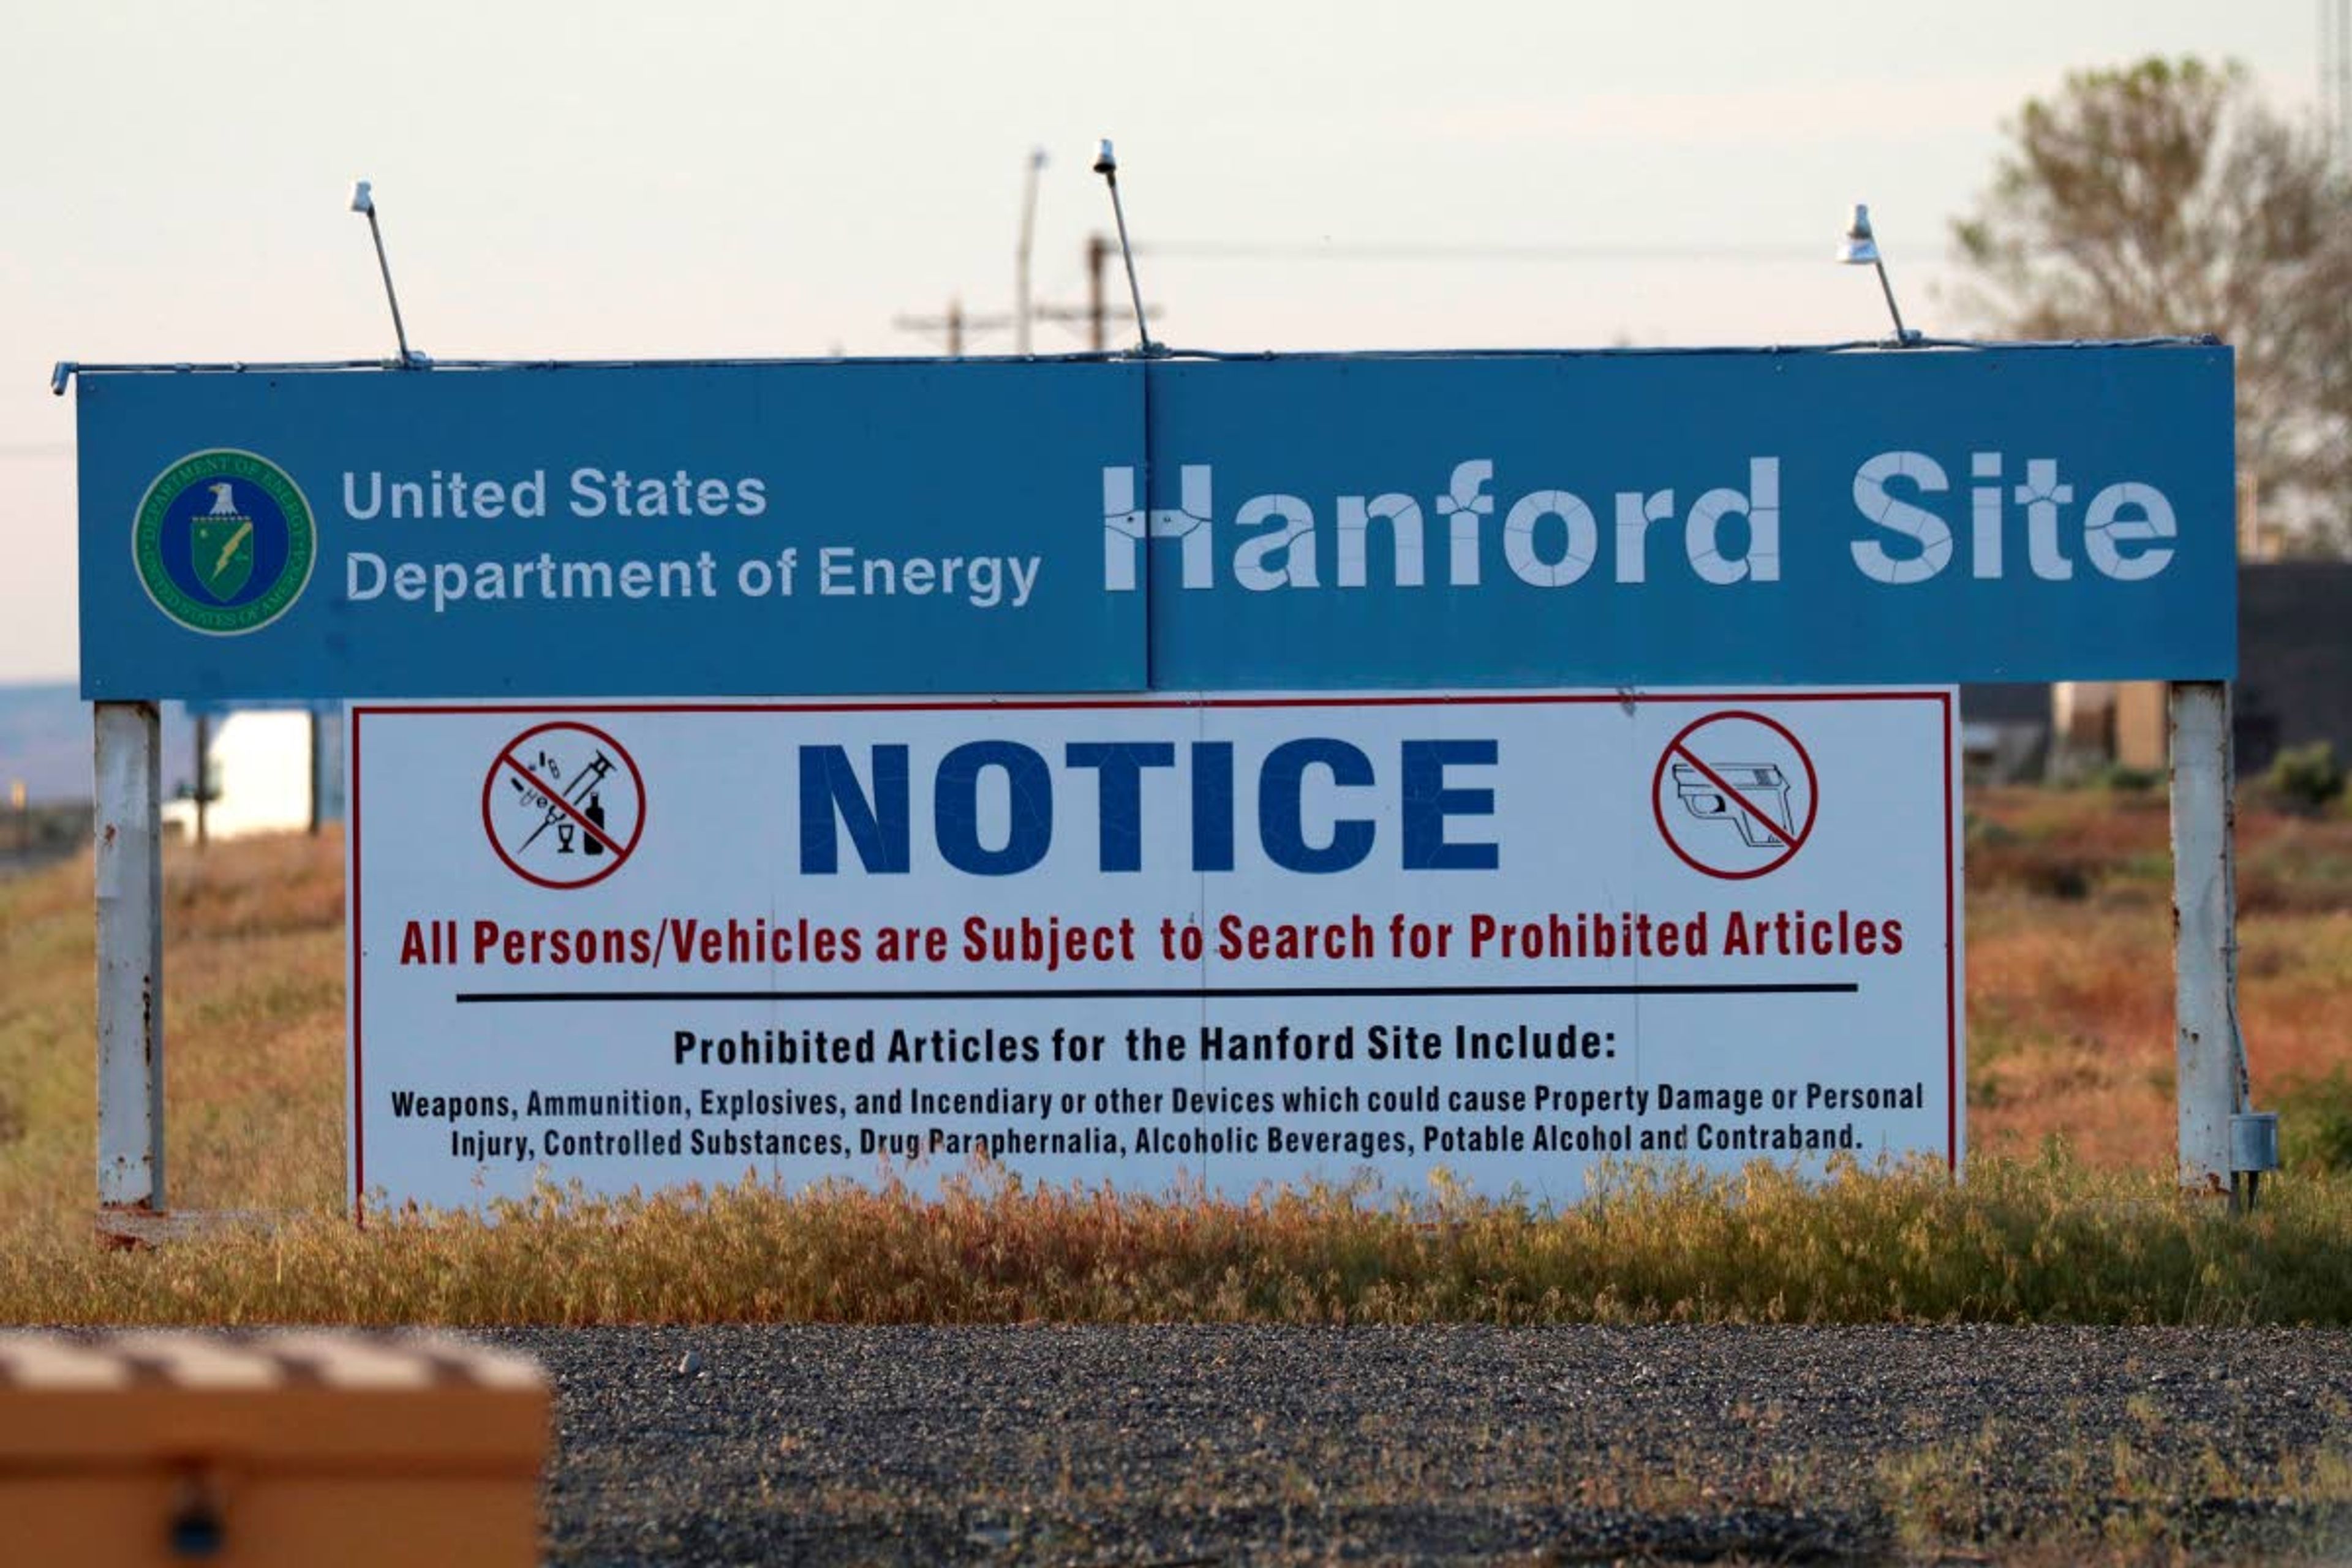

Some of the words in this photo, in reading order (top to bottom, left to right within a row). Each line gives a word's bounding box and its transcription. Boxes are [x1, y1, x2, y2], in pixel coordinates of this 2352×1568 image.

[343, 470, 546, 519] United
[570, 468, 767, 517] States
[1103, 457, 1781, 591] Hanford
[1850, 451, 2177, 584] Site
[347, 552, 717, 612] Department
[738, 548, 797, 597] of
[820, 547, 1041, 607] Energy
[800, 739, 1499, 875] NOTICE
[400, 919, 458, 965] All
[474, 917, 862, 968] Persons/Vehicles
[876, 927, 948, 963] are
[963, 916, 1135, 972] Subject
[1159, 918, 1204, 961] to
[1218, 913, 1374, 960] Search
[1389, 913, 1453, 959] for
[1471, 911, 1708, 959] Prohibited
[1722, 910, 1902, 956] Articles
[674, 1028, 875, 1065] Prohibited
[888, 1028, 1040, 1063] Articles
[1051, 1027, 1106, 1063] for
[1125, 1027, 1186, 1061] the
[1200, 1025, 1354, 1061] Hanford
[1368, 1025, 1442, 1060] Site
[1456, 1024, 1616, 1060] Include:
[391, 1091, 518, 1123] Weapons,
[526, 1089, 691, 1120] Ammunition,
[700, 1088, 846, 1121] Explosives,
[854, 1088, 902, 1115] and
[911, 1087, 1052, 1120] Incendiary
[1060, 1093, 1087, 1114] or
[1095, 1087, 1163, 1114] other
[1172, 1087, 1275, 1114] Devices
[1281, 1085, 1359, 1114] which
[1367, 1085, 1439, 1112] could
[1448, 1090, 1526, 1112] cause
[1534, 1084, 1649, 1117] Property
[1657, 1084, 1763, 1115] Damage
[1771, 1088, 1798, 1110] or
[1806, 1082, 1923, 1110] Personal
[451, 1130, 535, 1160] Injury,
[544, 1128, 682, 1156] Controlled
[690, 1128, 851, 1159] Substances,
[860, 1128, 920, 1159] Drug
[929, 1126, 1126, 1159] Paraphernalia,
[1134, 1126, 1258, 1154] Alcoholic
[1267, 1126, 1414, 1159] Beverages,
[1423, 1125, 1525, 1152] Potable
[1532, 1124, 1632, 1152] Alcohol
[1640, 1123, 1687, 1151] and
[1697, 1123, 1863, 1151] Contraband.
